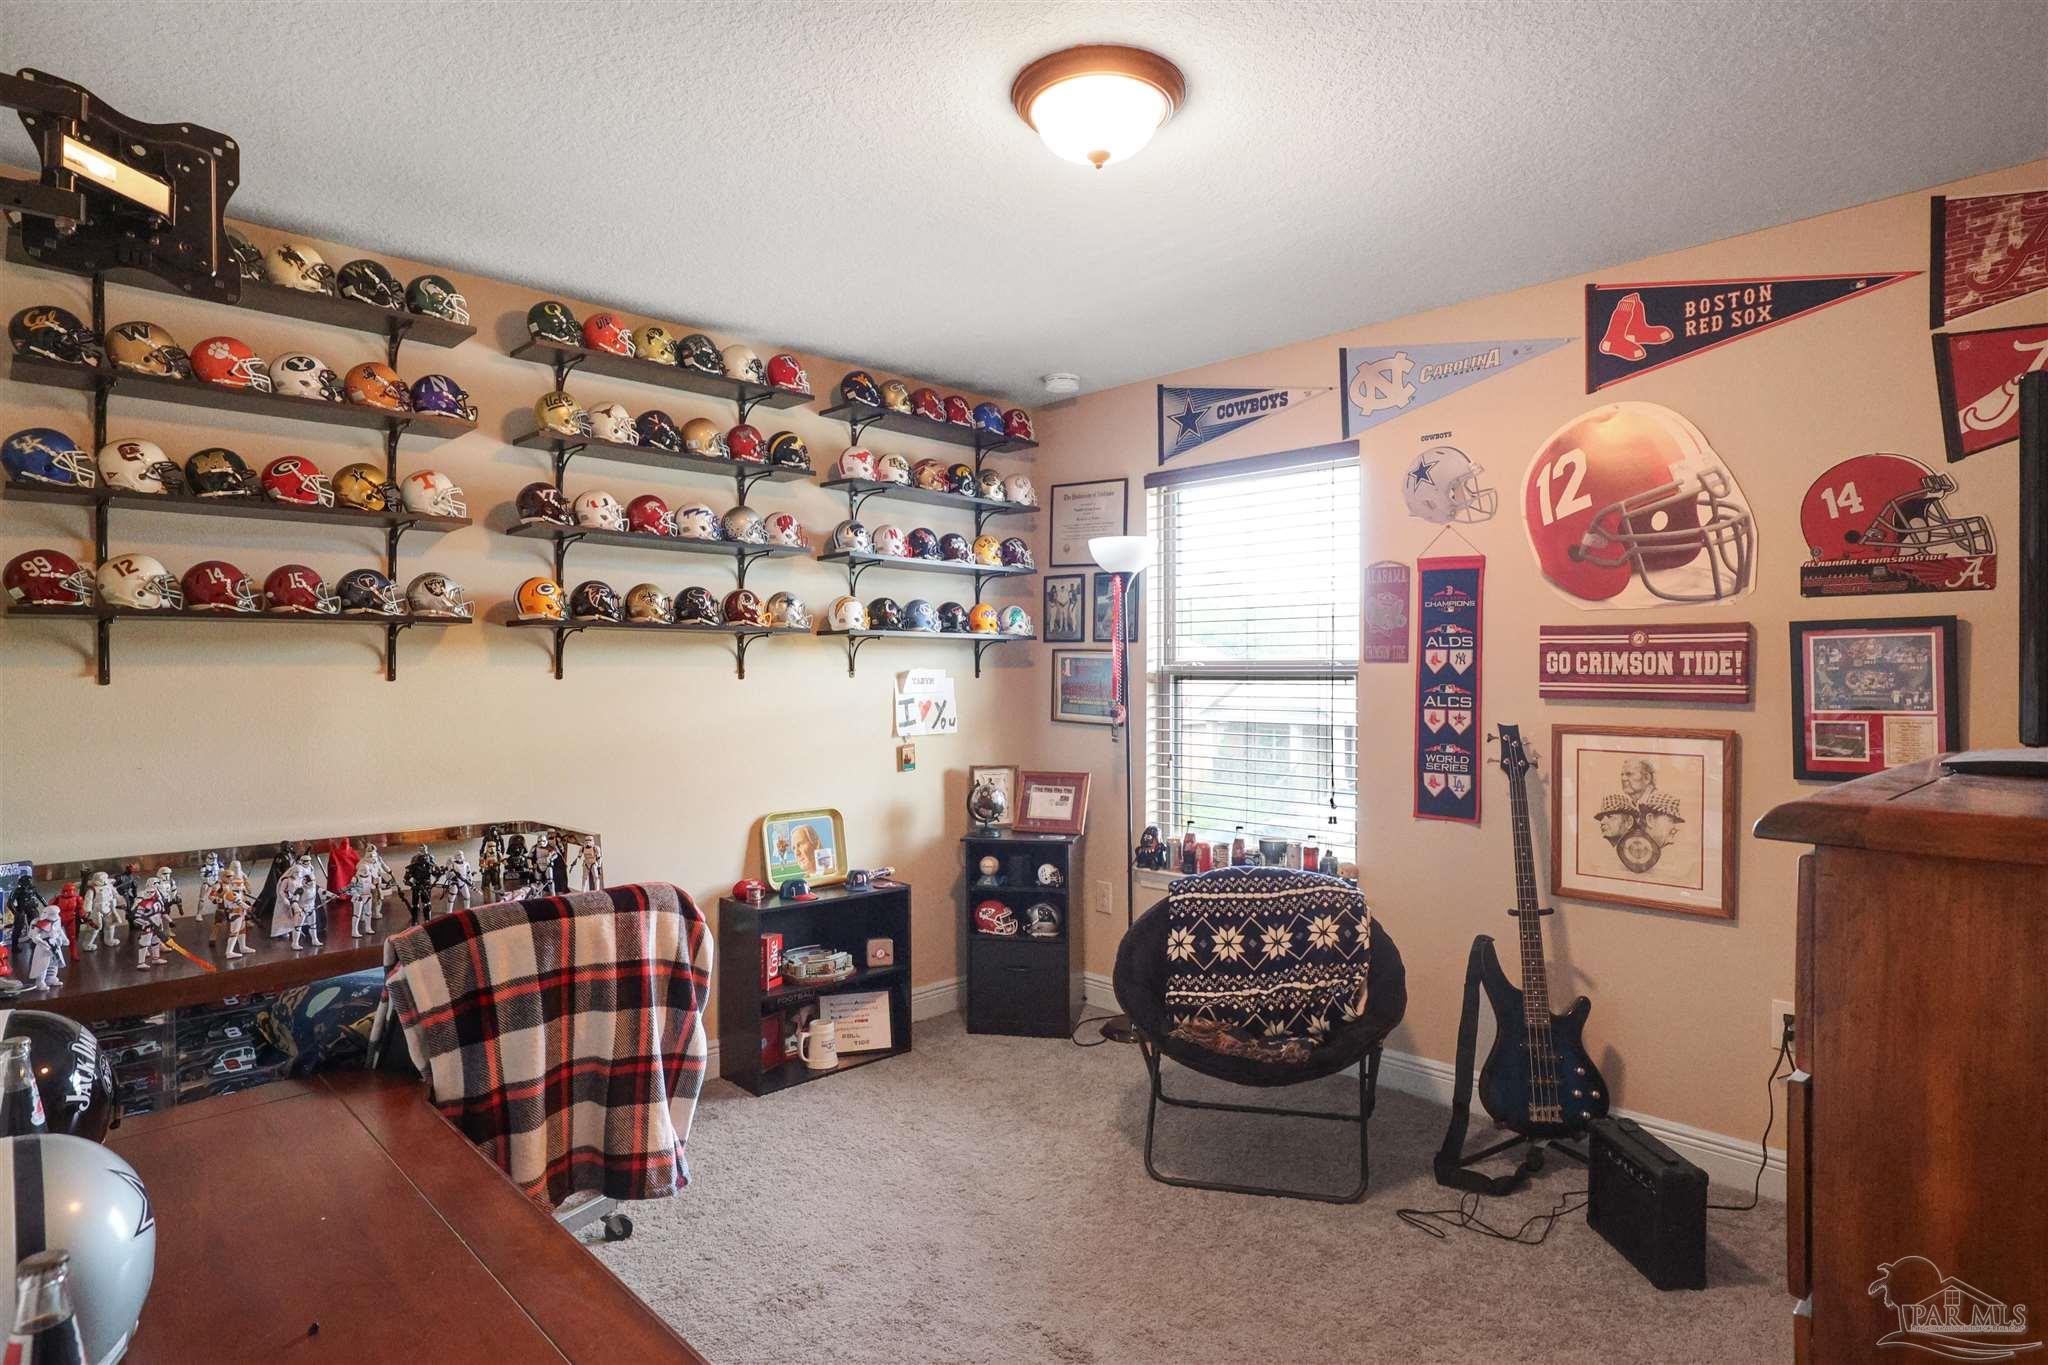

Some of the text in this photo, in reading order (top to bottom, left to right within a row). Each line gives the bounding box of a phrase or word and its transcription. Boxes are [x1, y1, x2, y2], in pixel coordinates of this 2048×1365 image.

[1684, 284, 1772, 318] BOSTON
[23, 310, 60, 331] Cal
[1685, 304, 1773, 337] RED SOX
[115, 325, 151, 342] W
[1419, 349, 1502, 384] CAROLINA
[1217, 391, 1289, 420] COWBOYS
[1420, 431, 1453, 442] COWBOYS
[411, 469, 436, 490] T
[1536, 448, 1592, 526] 12
[1821, 481, 1864, 520] 14
[21, 556, 52, 577] 99
[112, 559, 139, 577] 12
[1860, 556, 1917, 566] CRIMSON
[205, 567, 225, 584] 14
[288, 572, 306, 589] 15
[1945, 556, 1986, 589] A
[1424, 600, 1476, 608] CHAMPIONS
[1426, 636, 1473, 648] ALDS
[1546, 650, 1743, 676] GO CRIMSON TIDE!
[1424, 695, 1472, 708] ALCS
[898, 698, 956, 730] I You
[1425, 754, 1469, 764] WORLD
[1425, 763, 1468, 773] SERIES
[769, 940, 779, 977] Coke
[65, 1058, 95, 1112] JACK
